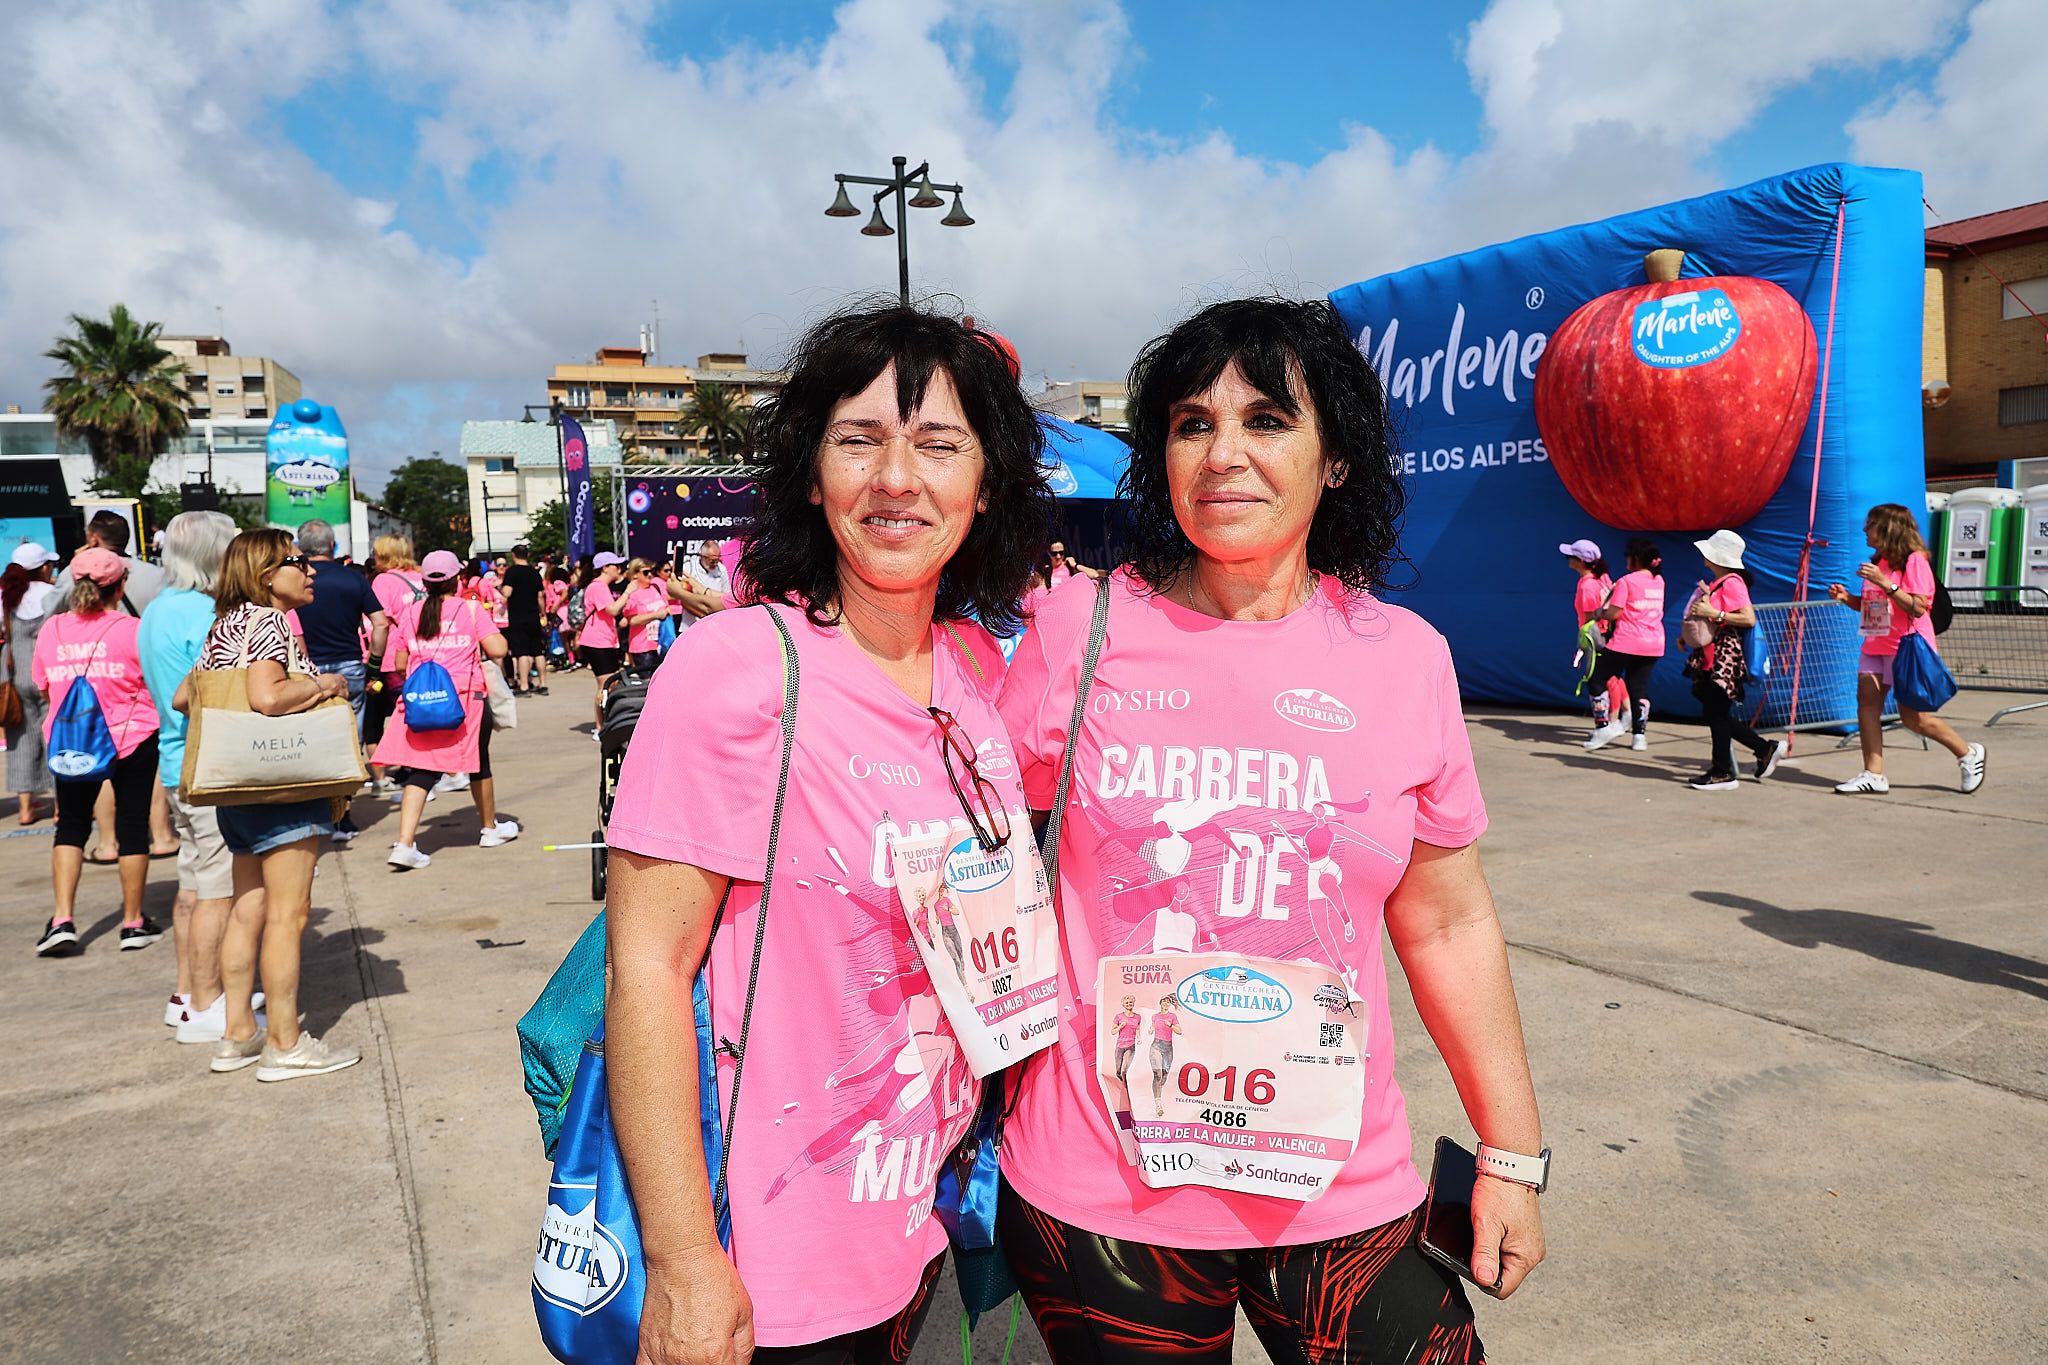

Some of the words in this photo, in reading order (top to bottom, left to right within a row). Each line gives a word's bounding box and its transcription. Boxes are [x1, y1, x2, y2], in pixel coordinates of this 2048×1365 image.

[1637, 303, 1732, 349] Marlene
[1637, 343, 1684, 364] DAUGHTER
[1685, 353, 1700, 363] OF
[1700, 345, 1720, 359] THE
[1720, 327, 1737, 349] ALPS
[1351, 303, 1549, 416] Marlene
[1422, 447, 1465, 473] LOS
[1470, 438, 1549, 468] ALPES
[682, 516, 733, 530] octopus
[56, 641, 107, 662] SOMOS
[1094, 688, 1191, 714] OYSHO
[1280, 697, 1350, 727] ASTURIANA
[260, 752, 302, 762] ALICANTE
[1097, 744, 1337, 817] CARRERA
[902, 850, 914, 860] TU
[949, 858, 1010, 882] ASTURIANA
[1215, 828, 1304, 921] DE
[970, 926, 1019, 974] 016
[1122, 971, 1172, 985] SUMA
[1135, 964, 1172, 972] DORSAL
[992, 975, 1012, 997] 4087
[1184, 982, 1284, 1012] ASTURIANA
[1203, 983, 1239, 992] CENTRAL
[1177, 1062, 1276, 1105] 016
[1199, 1108, 1247, 1128] 4086
[1132, 1121, 1172, 1139] RRERA
[1174, 1127, 1191, 1139] DE
[1193, 1127, 1209, 1141] LA
[1213, 1132, 1256, 1147] MUJER
[1268, 1137, 1327, 1155] VALENCIA
[1246, 1163, 1323, 1187] Santander
